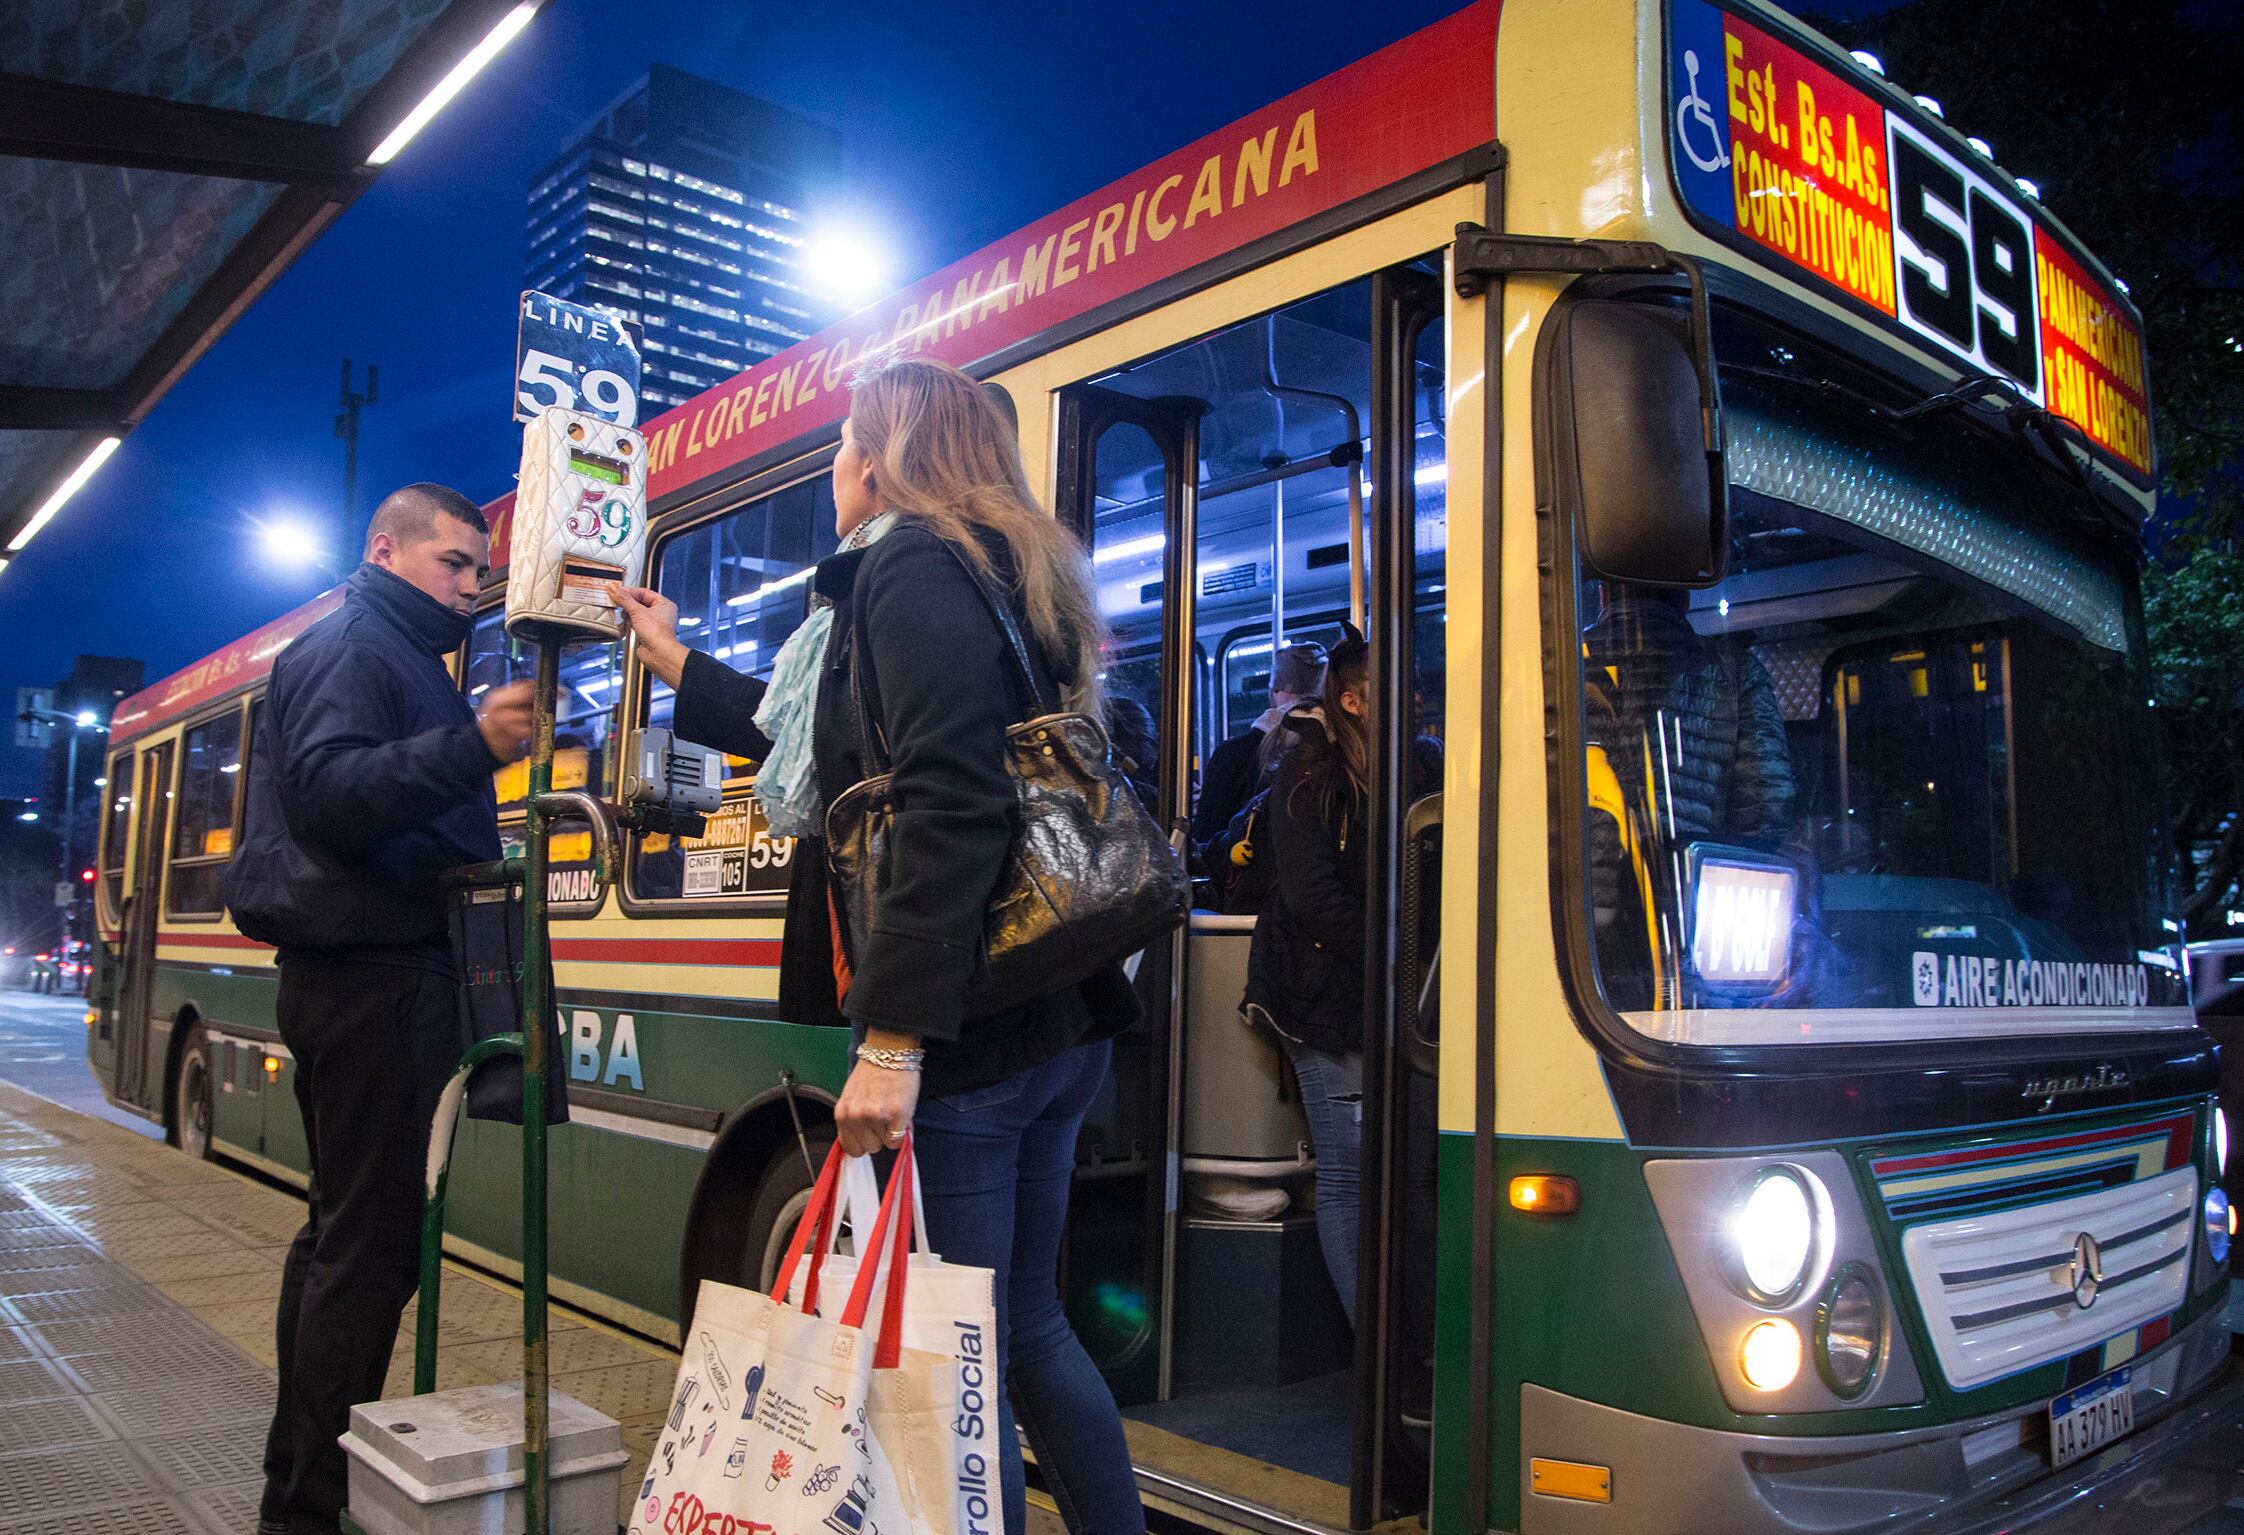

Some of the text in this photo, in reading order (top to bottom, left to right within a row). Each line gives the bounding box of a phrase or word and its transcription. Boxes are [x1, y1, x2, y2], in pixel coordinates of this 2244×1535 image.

[1725, 32, 1789, 149] Est.
[1733, 140, 1894, 309] CONSTITUCION
[1892, 126, 2037, 394] 59
[641, 108, 1319, 475] AN LORENZO PANAMERICANA
[518, 348, 637, 428] 59
[2044, 346, 2150, 475] Y SAN LORENZO
[567, 489, 631, 548] 59
[688, 856, 719, 868] CNRT
[721, 861, 742, 887] 105
[750, 831, 793, 869] 59
[1944, 954, 2148, 1007] AIRE ACONDICIONADO
[557, 1010, 645, 1091] BA
[954, 1321, 984, 1440] Social
